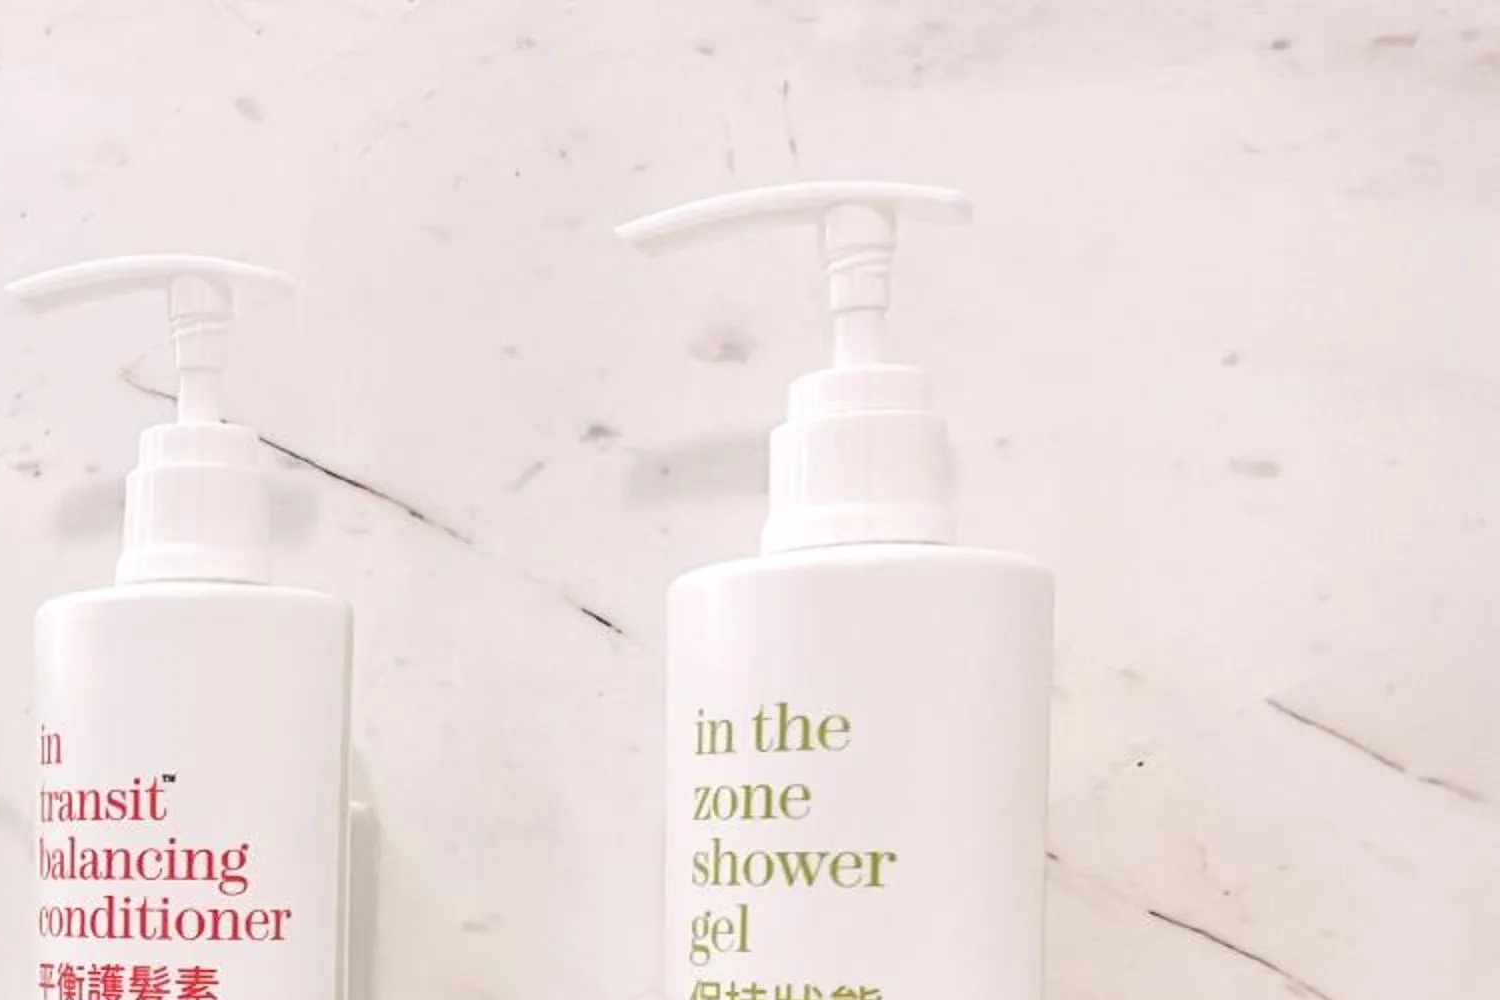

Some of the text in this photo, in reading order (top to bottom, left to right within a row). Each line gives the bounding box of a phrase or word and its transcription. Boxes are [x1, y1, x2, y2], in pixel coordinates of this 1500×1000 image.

[40, 724, 62, 765] in
[694, 701, 852, 756] in the
[691, 783, 813, 822] zone
[39, 836, 249, 896] balancing
[691, 836, 898, 889] shower
[39, 895, 292, 941] conditioner
[689, 903, 752, 967] gel
